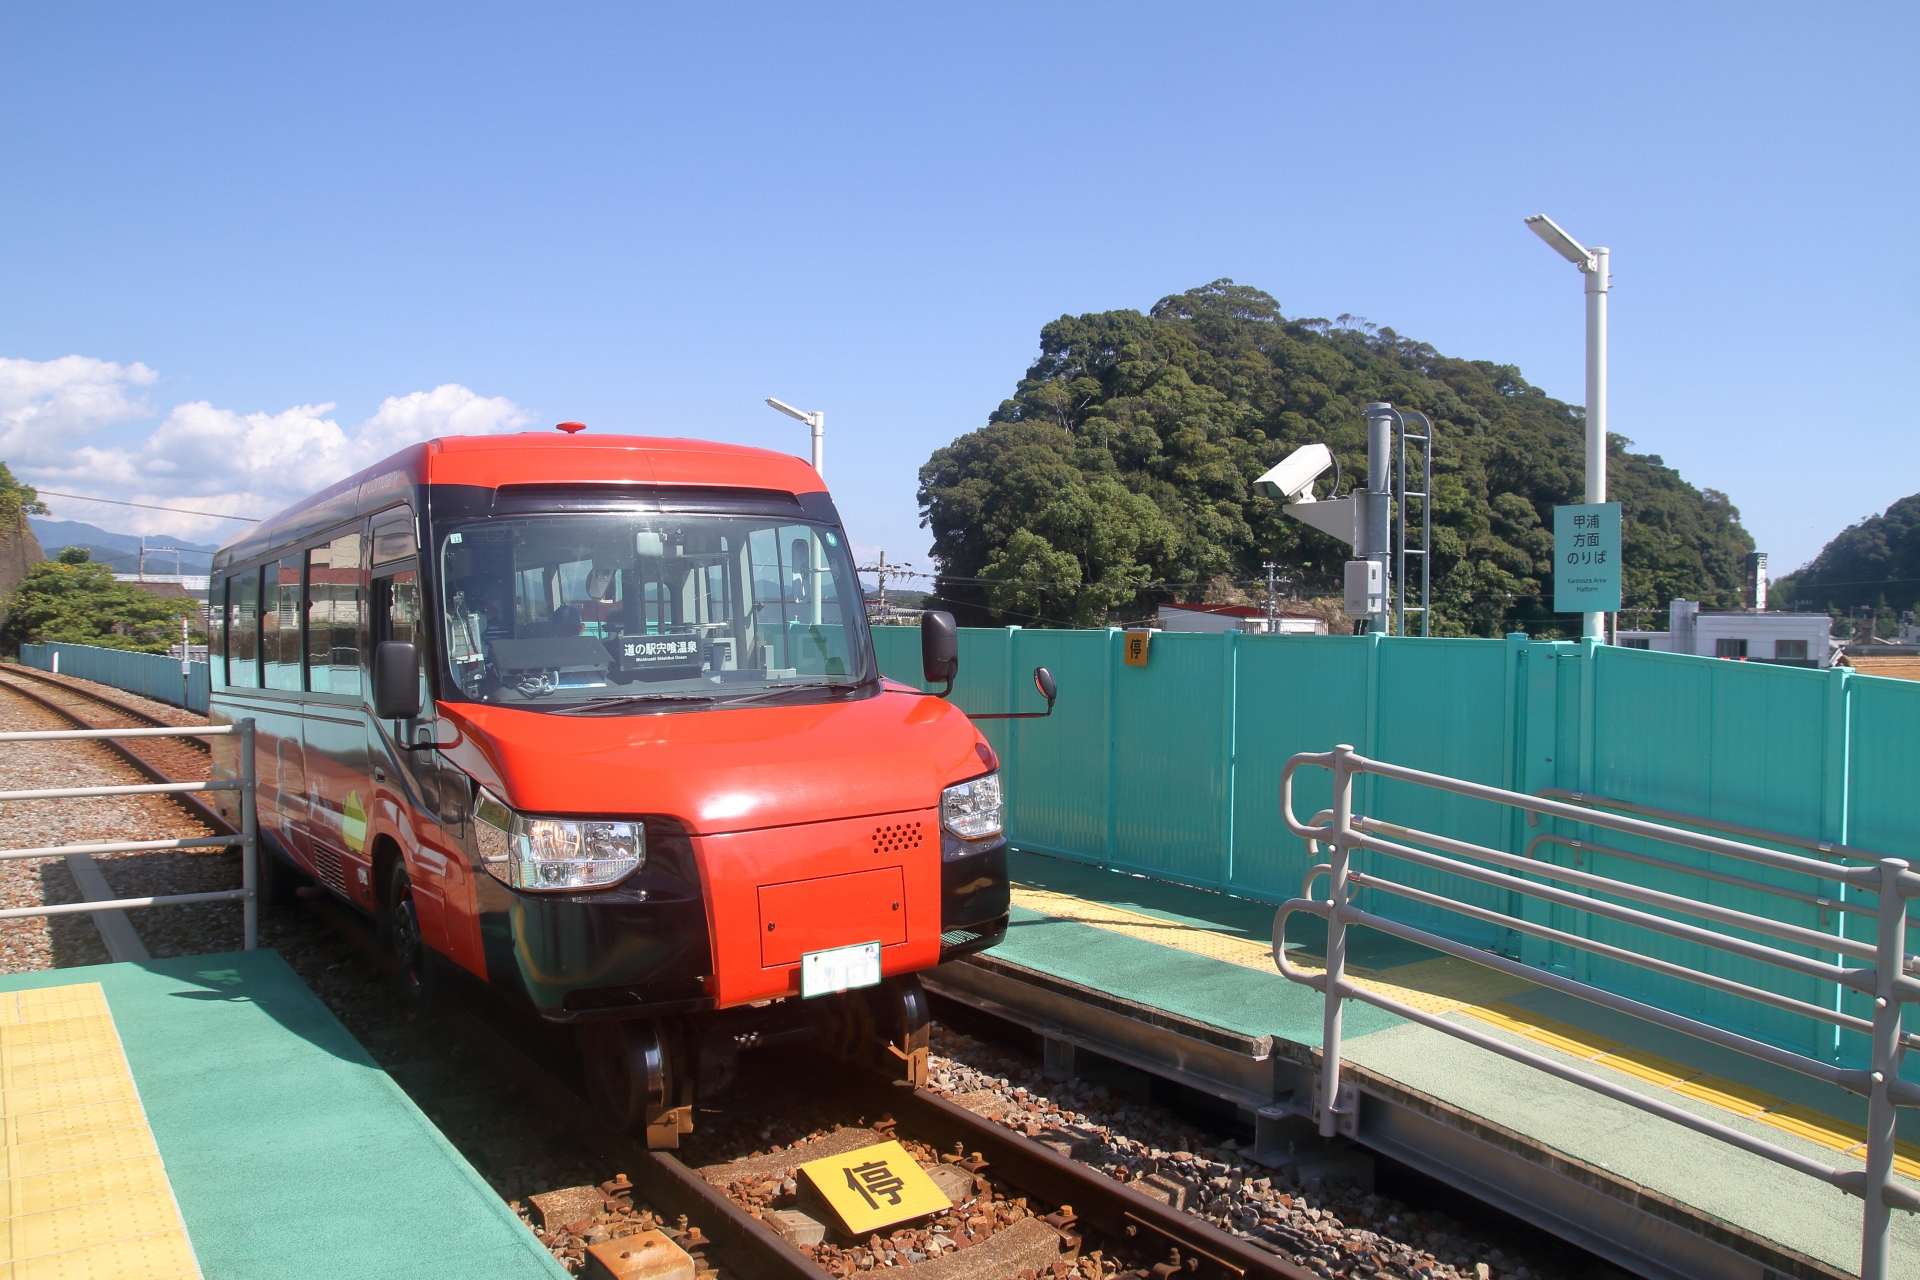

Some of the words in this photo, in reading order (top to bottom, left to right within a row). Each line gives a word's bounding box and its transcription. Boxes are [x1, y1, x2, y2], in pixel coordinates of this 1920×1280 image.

[1573, 514, 1600, 529] 甲浦
[1573, 533, 1600, 548] 方面
[1567, 550, 1607, 565] のりば
[624, 641, 698, 657] 道の駅宍喰温泉
[1130, 638, 1142, 659] 停
[842, 1160, 905, 1210] 停
